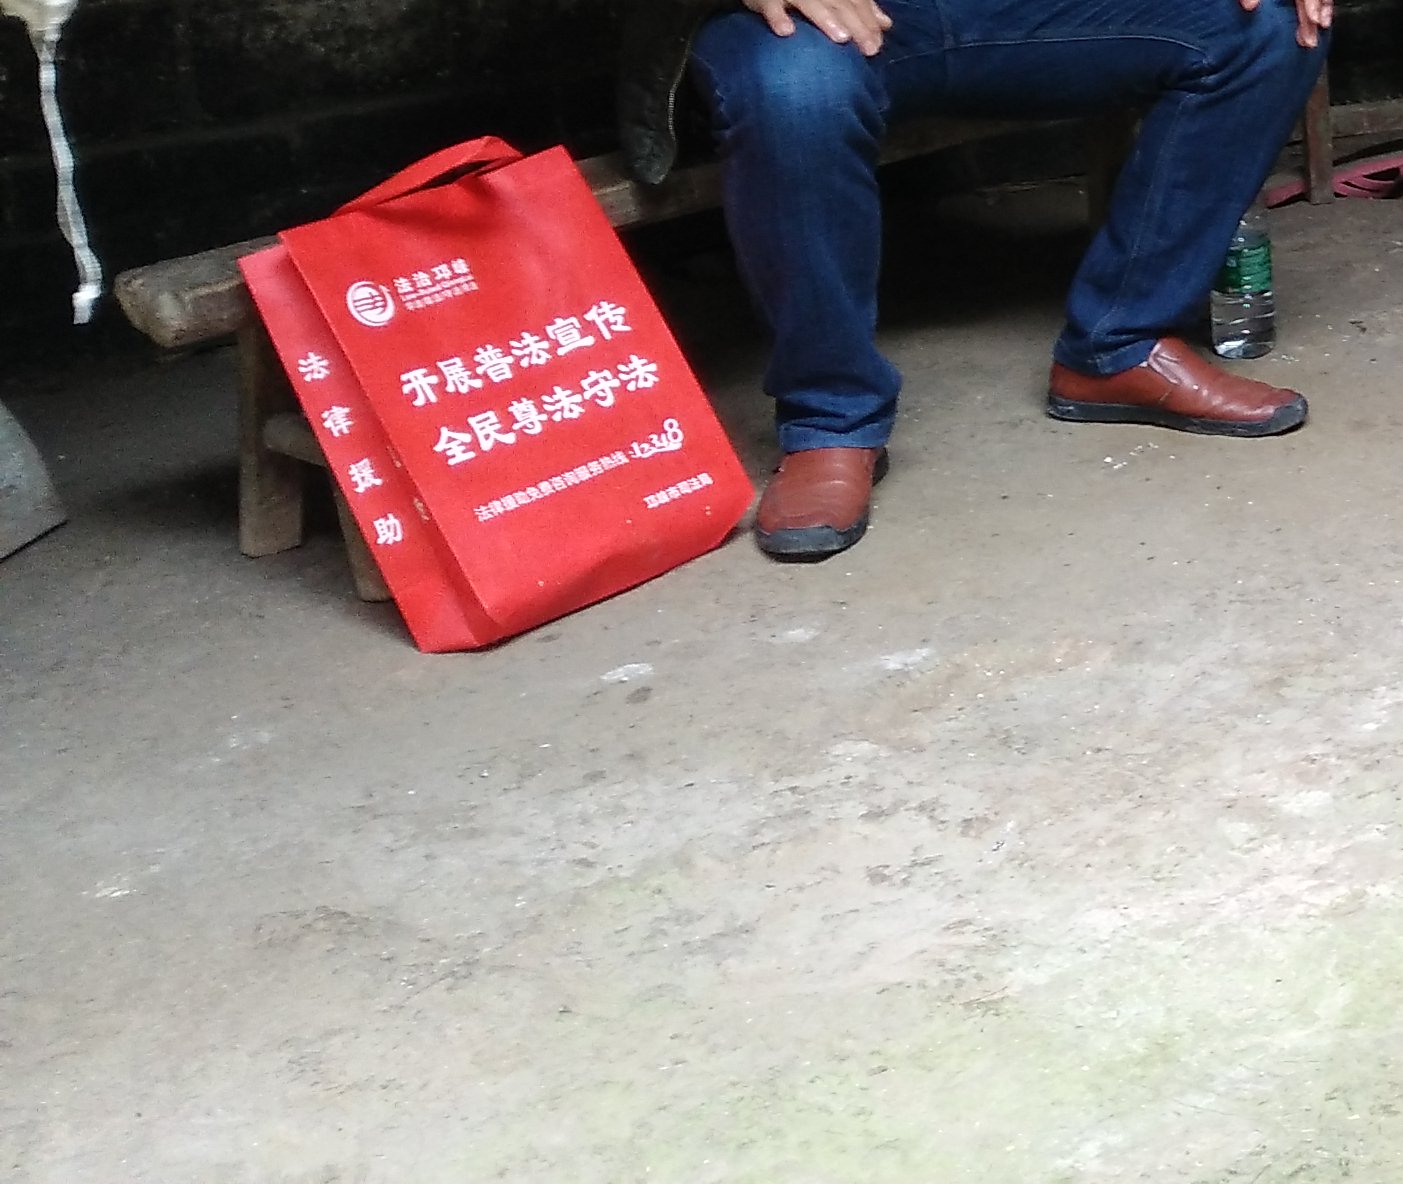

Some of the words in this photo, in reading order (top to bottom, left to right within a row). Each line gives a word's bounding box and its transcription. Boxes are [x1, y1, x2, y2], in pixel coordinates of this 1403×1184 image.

[400, 301, 632, 407] 开展普法宣传
[433, 354, 660, 466] 全民尊法守法
[298, 352, 404, 545] 法律援助
